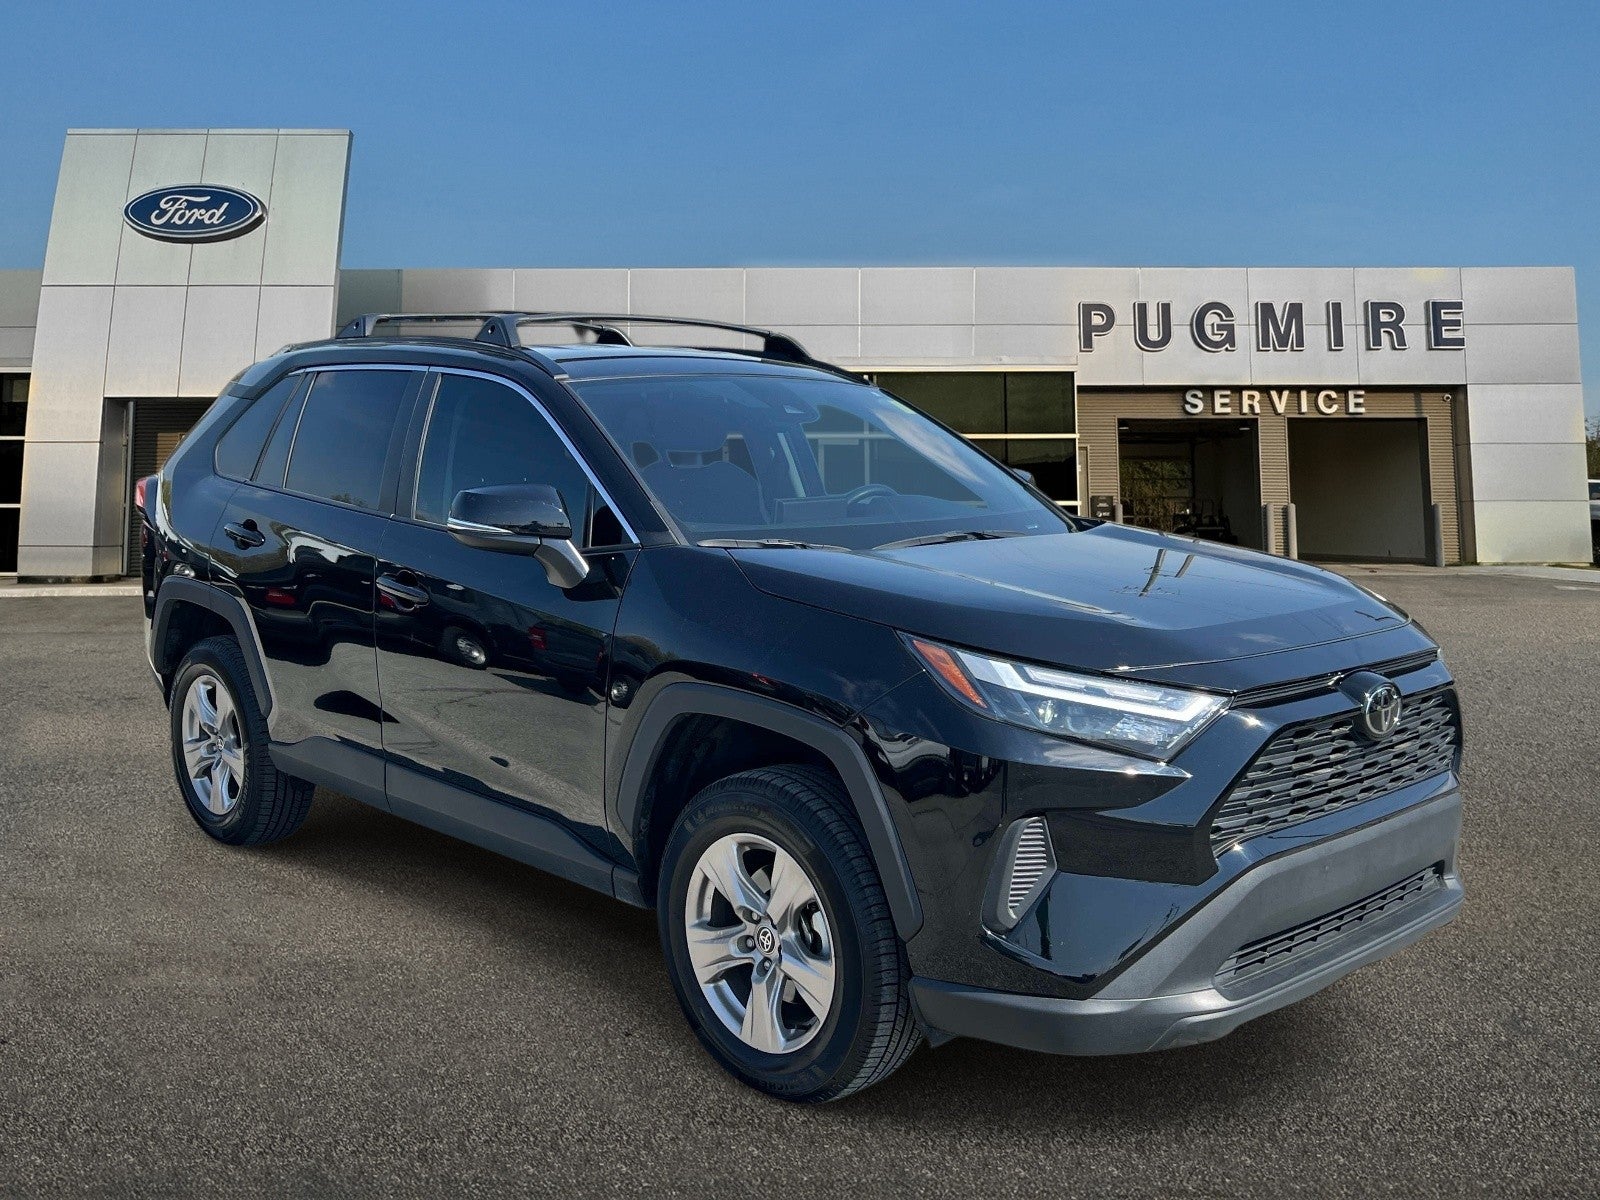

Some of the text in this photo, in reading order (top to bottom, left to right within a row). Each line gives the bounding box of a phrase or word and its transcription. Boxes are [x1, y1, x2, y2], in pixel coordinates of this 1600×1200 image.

[150, 195, 229, 225] Ford
[1079, 299, 1466, 352] PUGMIRE
[1184, 389, 1366, 415] SERVICE
